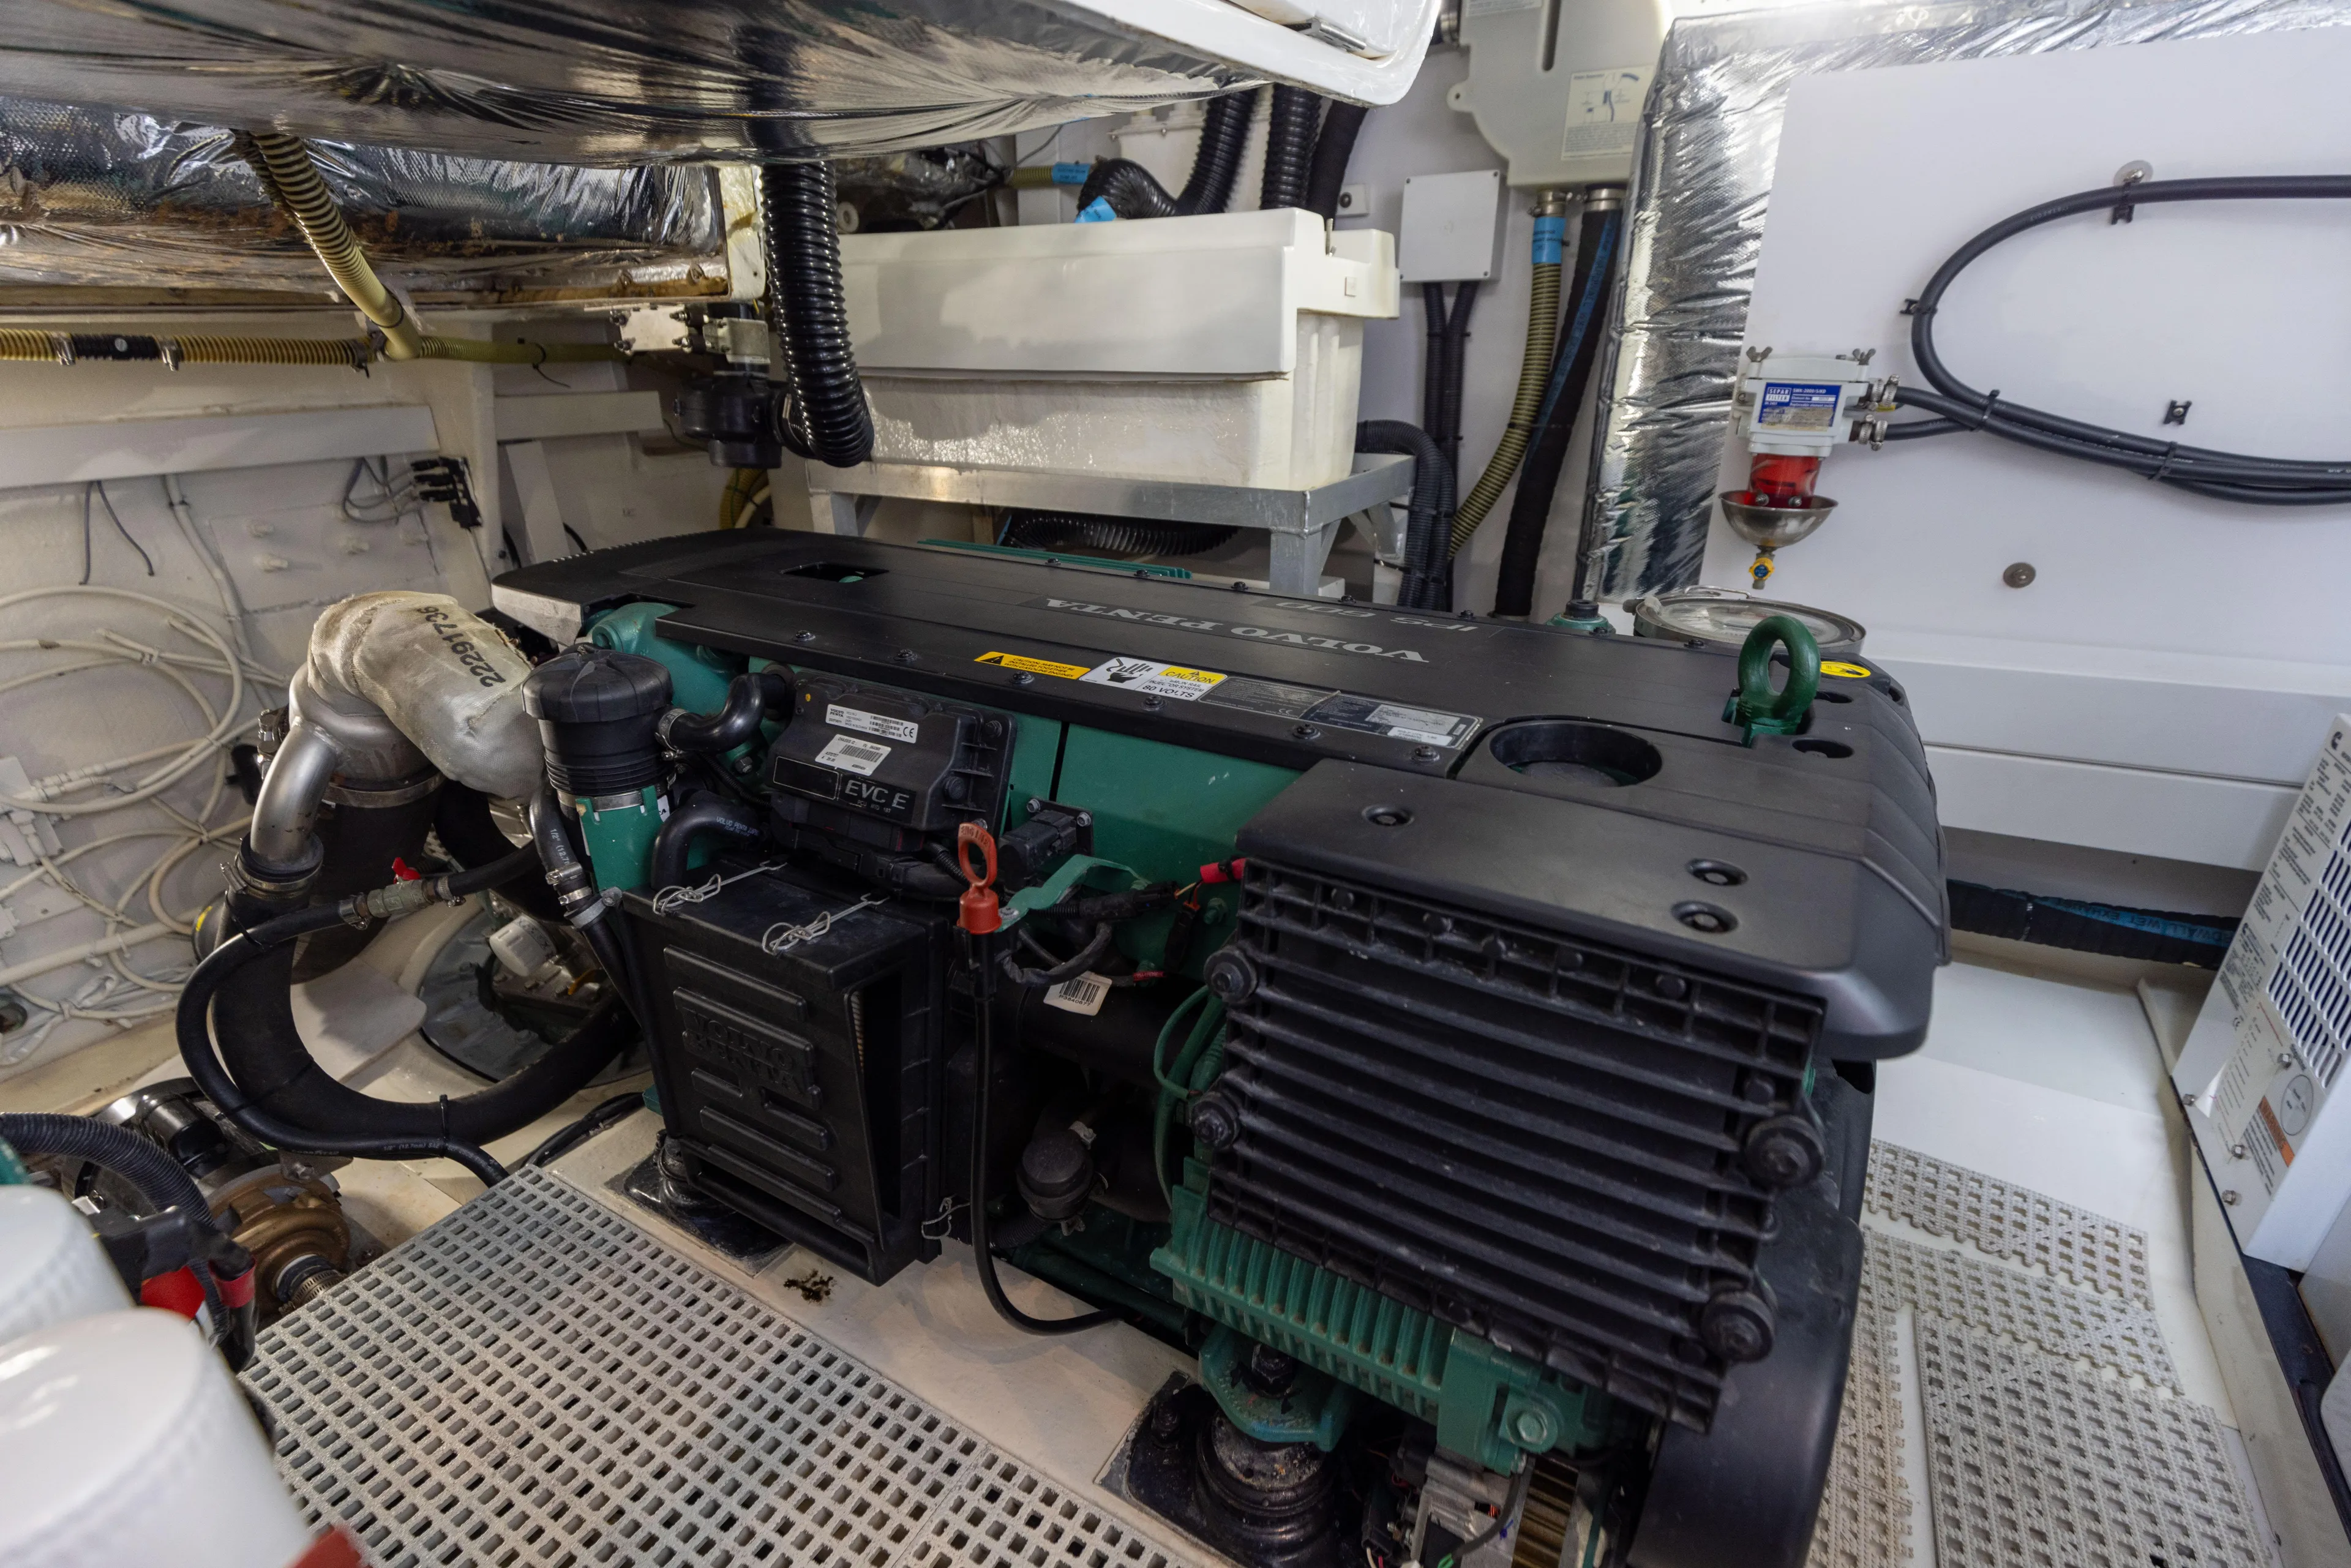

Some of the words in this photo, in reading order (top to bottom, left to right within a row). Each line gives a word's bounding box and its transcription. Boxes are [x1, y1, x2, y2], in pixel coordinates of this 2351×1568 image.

[1046, 598, 1224, 631] PENTA
[1275, 602, 1376, 618] 600
[1390, 617, 1479, 632] IPS
[416, 606, 506, 688] 22291736
[1231, 627, 1430, 663] VOLVO
[1165, 671, 1216, 683] CAUTION
[1158, 687, 1195, 698] VOLTS
[902, 726, 915, 738] CE
[844, 779, 889, 803] EVC
[891, 792, 910, 809] E
[716, 816, 733, 827] VOLVO
[735, 820, 748, 831] PENTA
